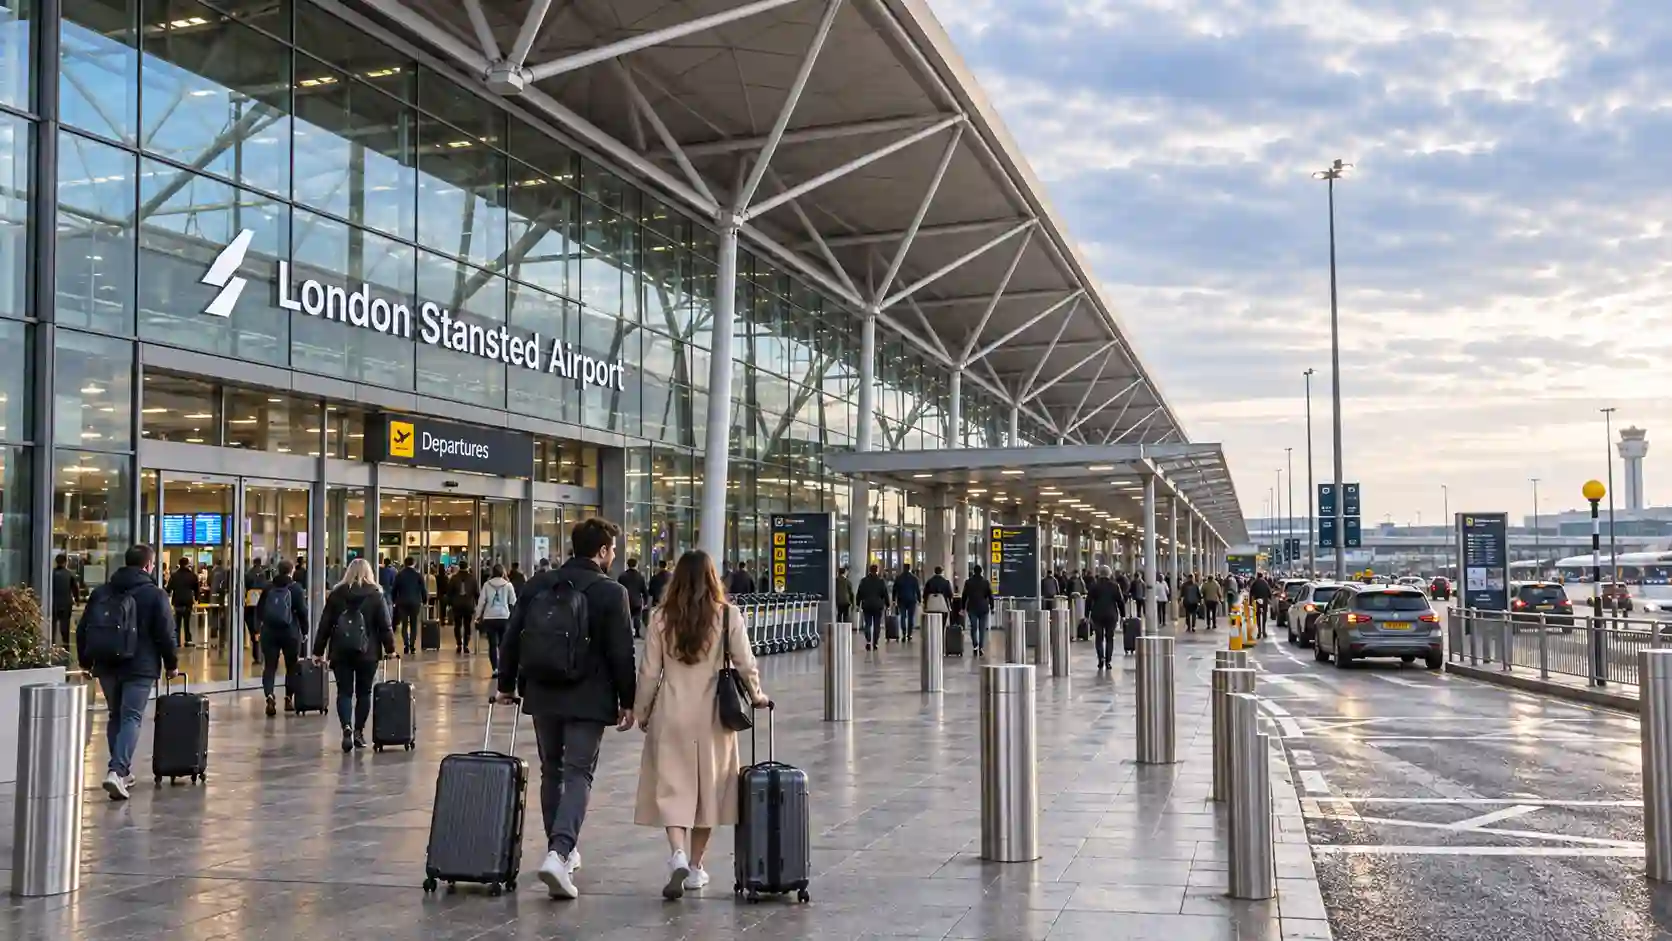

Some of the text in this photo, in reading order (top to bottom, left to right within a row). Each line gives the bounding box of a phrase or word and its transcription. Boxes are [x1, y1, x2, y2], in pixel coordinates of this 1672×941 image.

[278, 260, 624, 391] London Stansted Airport
[422, 431, 489, 459] Departures
